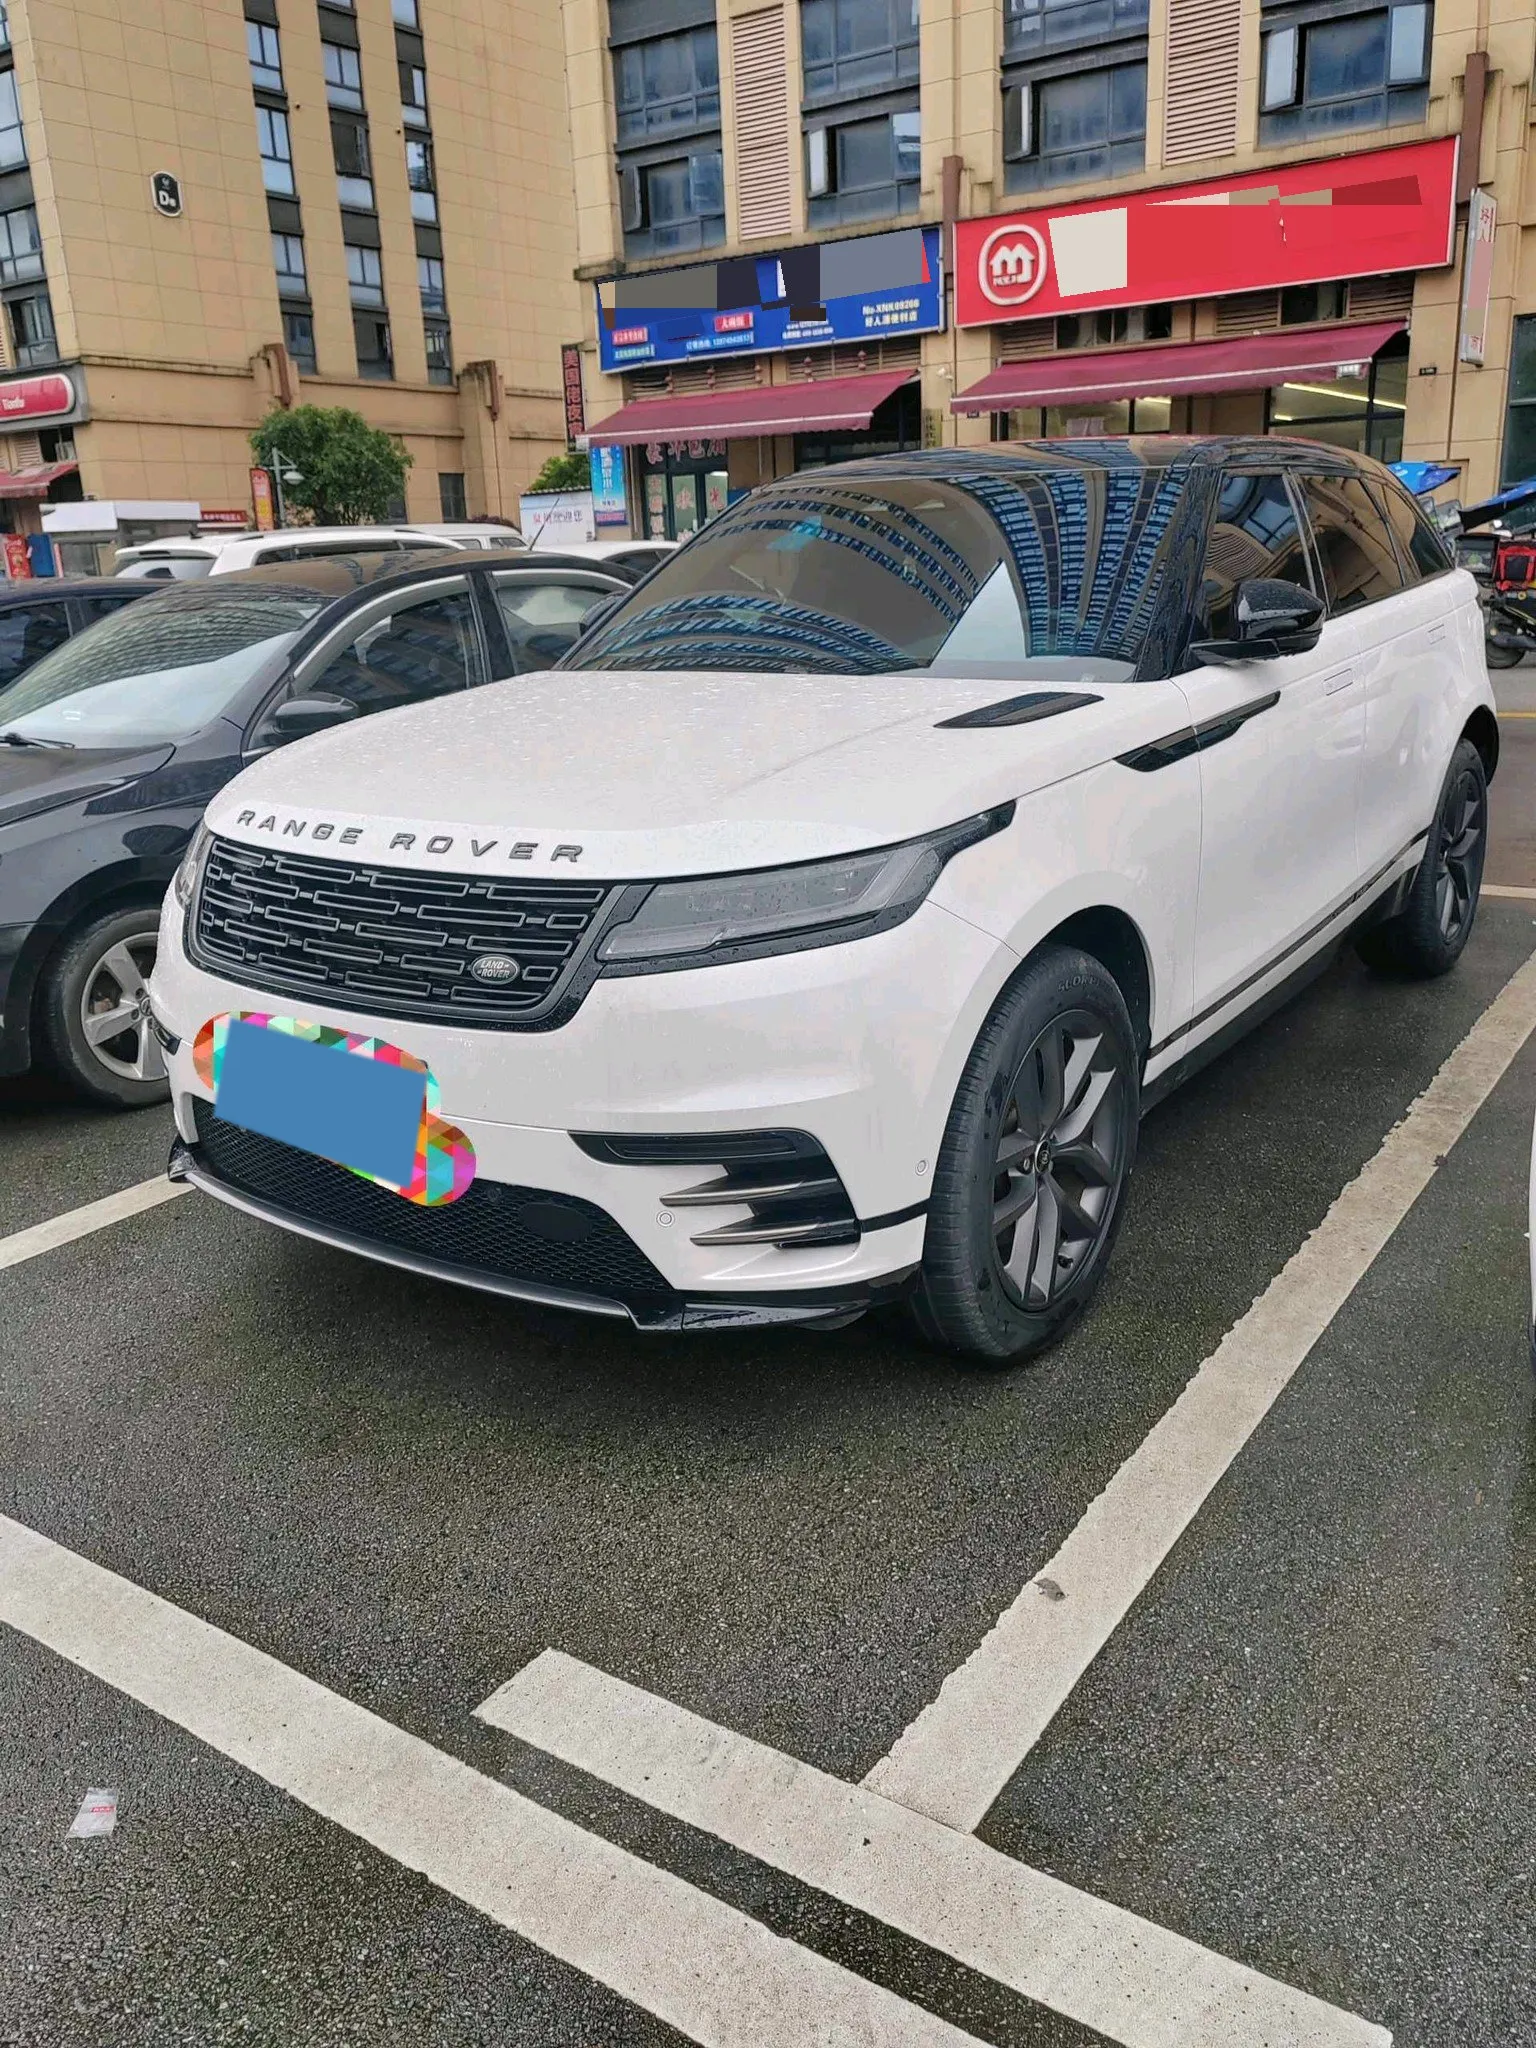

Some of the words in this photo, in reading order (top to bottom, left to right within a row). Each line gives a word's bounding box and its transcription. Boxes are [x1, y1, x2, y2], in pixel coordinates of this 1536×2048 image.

[236, 810, 363, 845] RANGE
[389, 832, 584, 863] ROVER
[480, 960, 504, 969] LAND
[480, 969, 511, 979] ROVER
